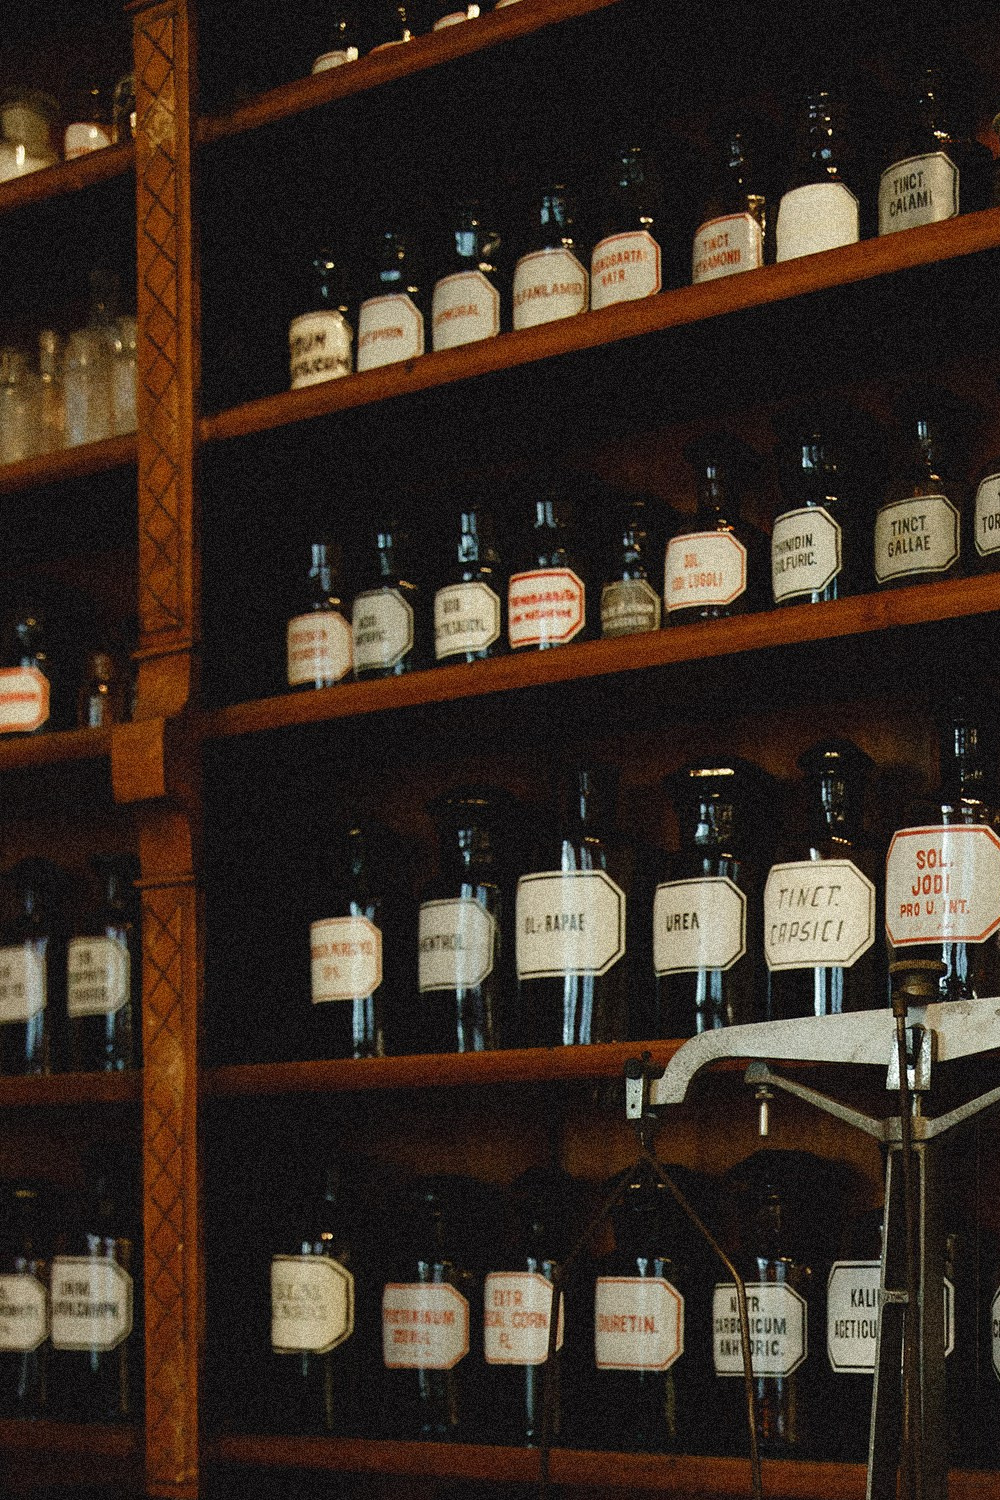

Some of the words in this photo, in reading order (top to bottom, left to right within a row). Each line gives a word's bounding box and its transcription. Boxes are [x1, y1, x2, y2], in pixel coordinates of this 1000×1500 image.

[889, 189, 932, 217] CALAMI
[887, 536, 932, 558] GALLAE
[915, 847, 956, 871] SOL.
[911, 873, 951, 897] JODI
[778, 885, 842, 910] TINCT.
[899, 901, 921, 919] PRO
[925, 898, 939, 916] U.
[544, 912, 586, 933] RAPAE
[665, 912, 700, 933] UREA
[770, 920, 844, 947] CAPSICI
[730, 1296, 765, 1313] NTR.
[851, 1289, 881, 1309] KALI
[715, 1317, 787, 1337] CARBOICUM
[719, 1339, 785, 1358] ANHDRIC.
